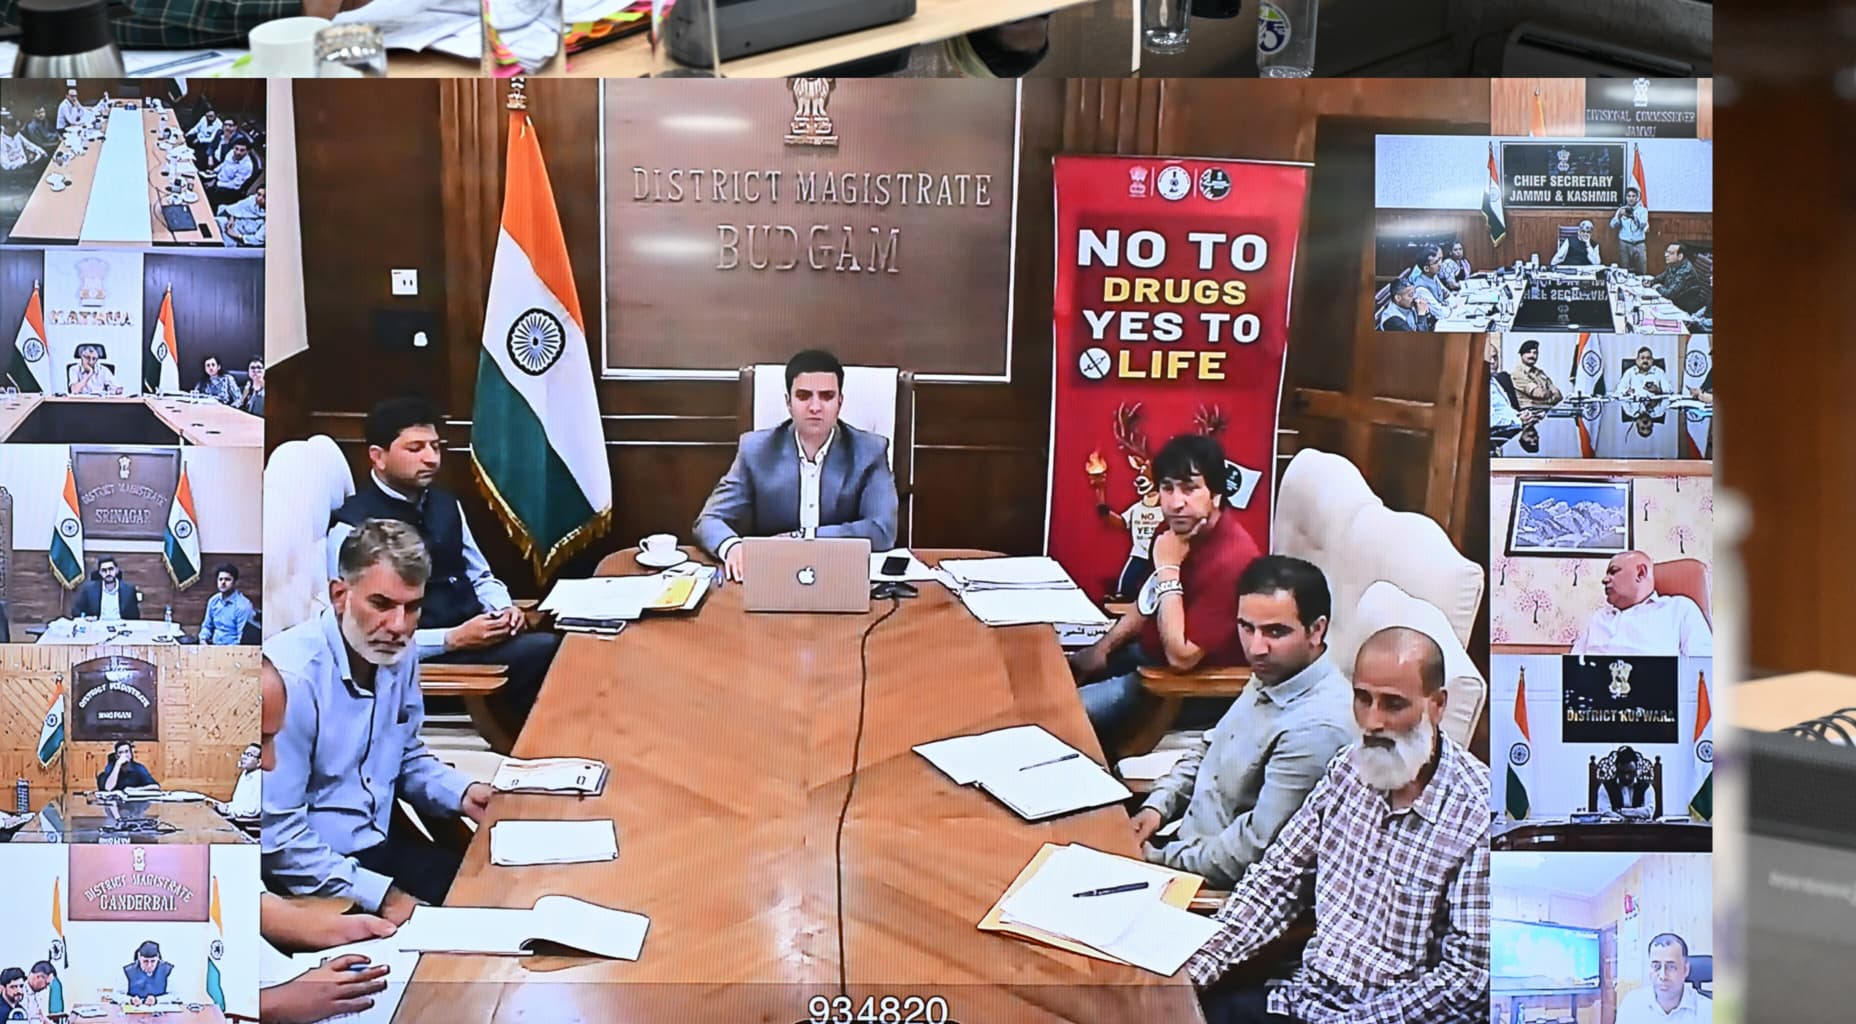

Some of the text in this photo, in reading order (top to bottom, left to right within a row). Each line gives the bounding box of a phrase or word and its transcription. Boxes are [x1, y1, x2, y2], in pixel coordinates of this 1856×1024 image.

[632, 167, 992, 207] DISTRICT MAGISTRATE
[1509, 190, 1618, 202] JAMMU & KASHMIR
[1513, 175, 1614, 188] CHIEF SECRETARY
[716, 225, 900, 274] BUDGAM
[1077, 229, 1268, 272] NO TO
[1103, 276, 1247, 306] DRUGS
[1082, 309, 1261, 343] YES TO
[1118, 349, 1227, 380] LIFE
[1566, 708, 1617, 722] DISTRICT
[84, 874, 128, 902] DISTRICT
[808, 996, 949, 1024] 934820
